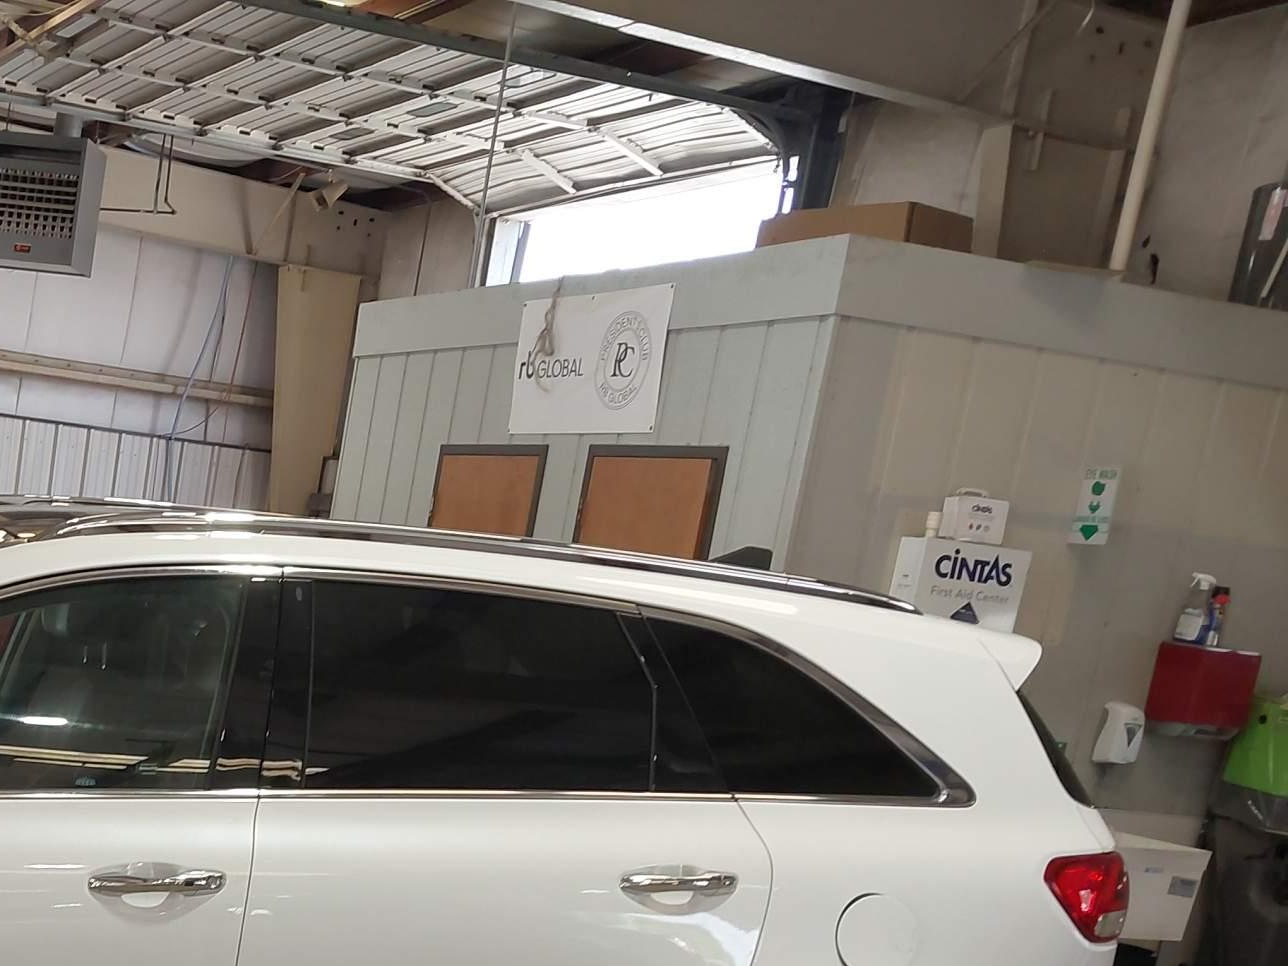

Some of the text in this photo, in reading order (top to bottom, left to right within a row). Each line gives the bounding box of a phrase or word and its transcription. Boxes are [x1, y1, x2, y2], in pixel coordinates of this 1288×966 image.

[537, 358, 584, 379] GLOBAL
[930, 585, 1009, 603] First Aid Center
